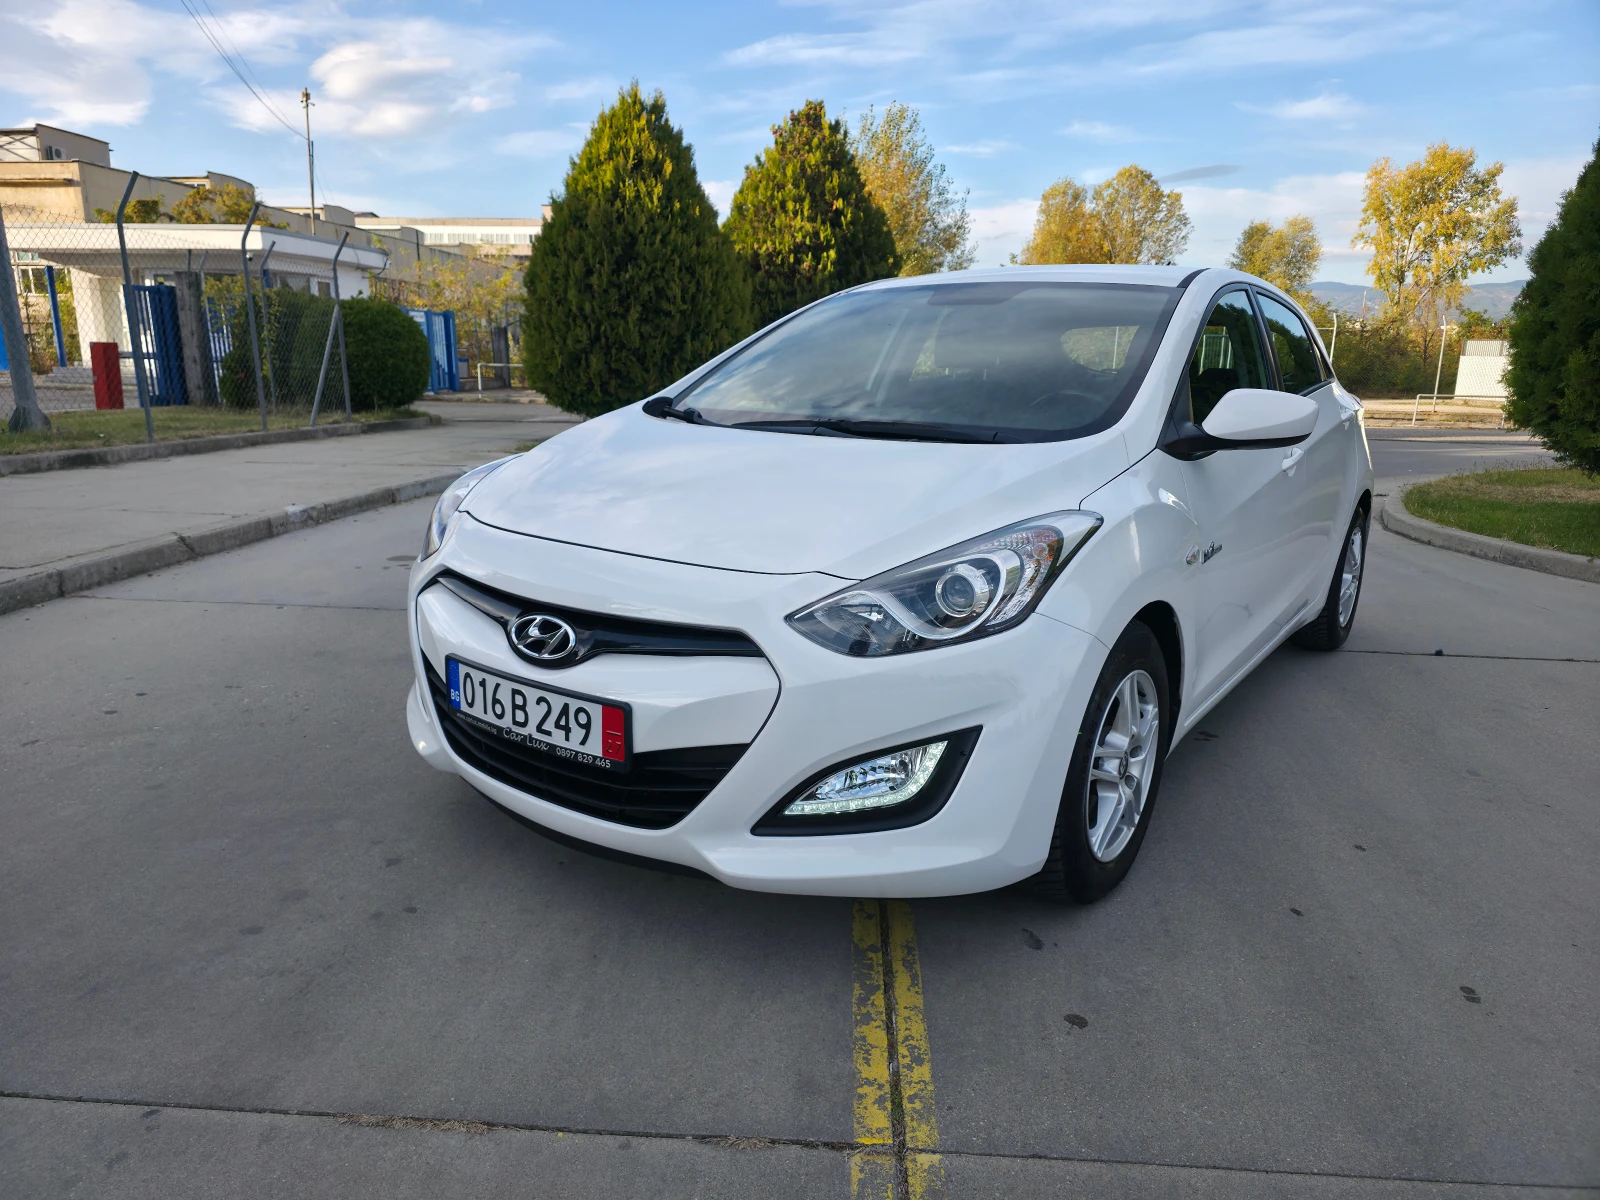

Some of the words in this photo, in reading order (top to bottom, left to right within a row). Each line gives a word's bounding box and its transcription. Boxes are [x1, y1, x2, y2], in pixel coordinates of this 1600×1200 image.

[450, 689, 460, 702] BG
[503, 727, 524, 742] Car
[555, 747, 576, 759] 0897
[577, 753, 593, 764] 829
[594, 757, 611, 768] 465
